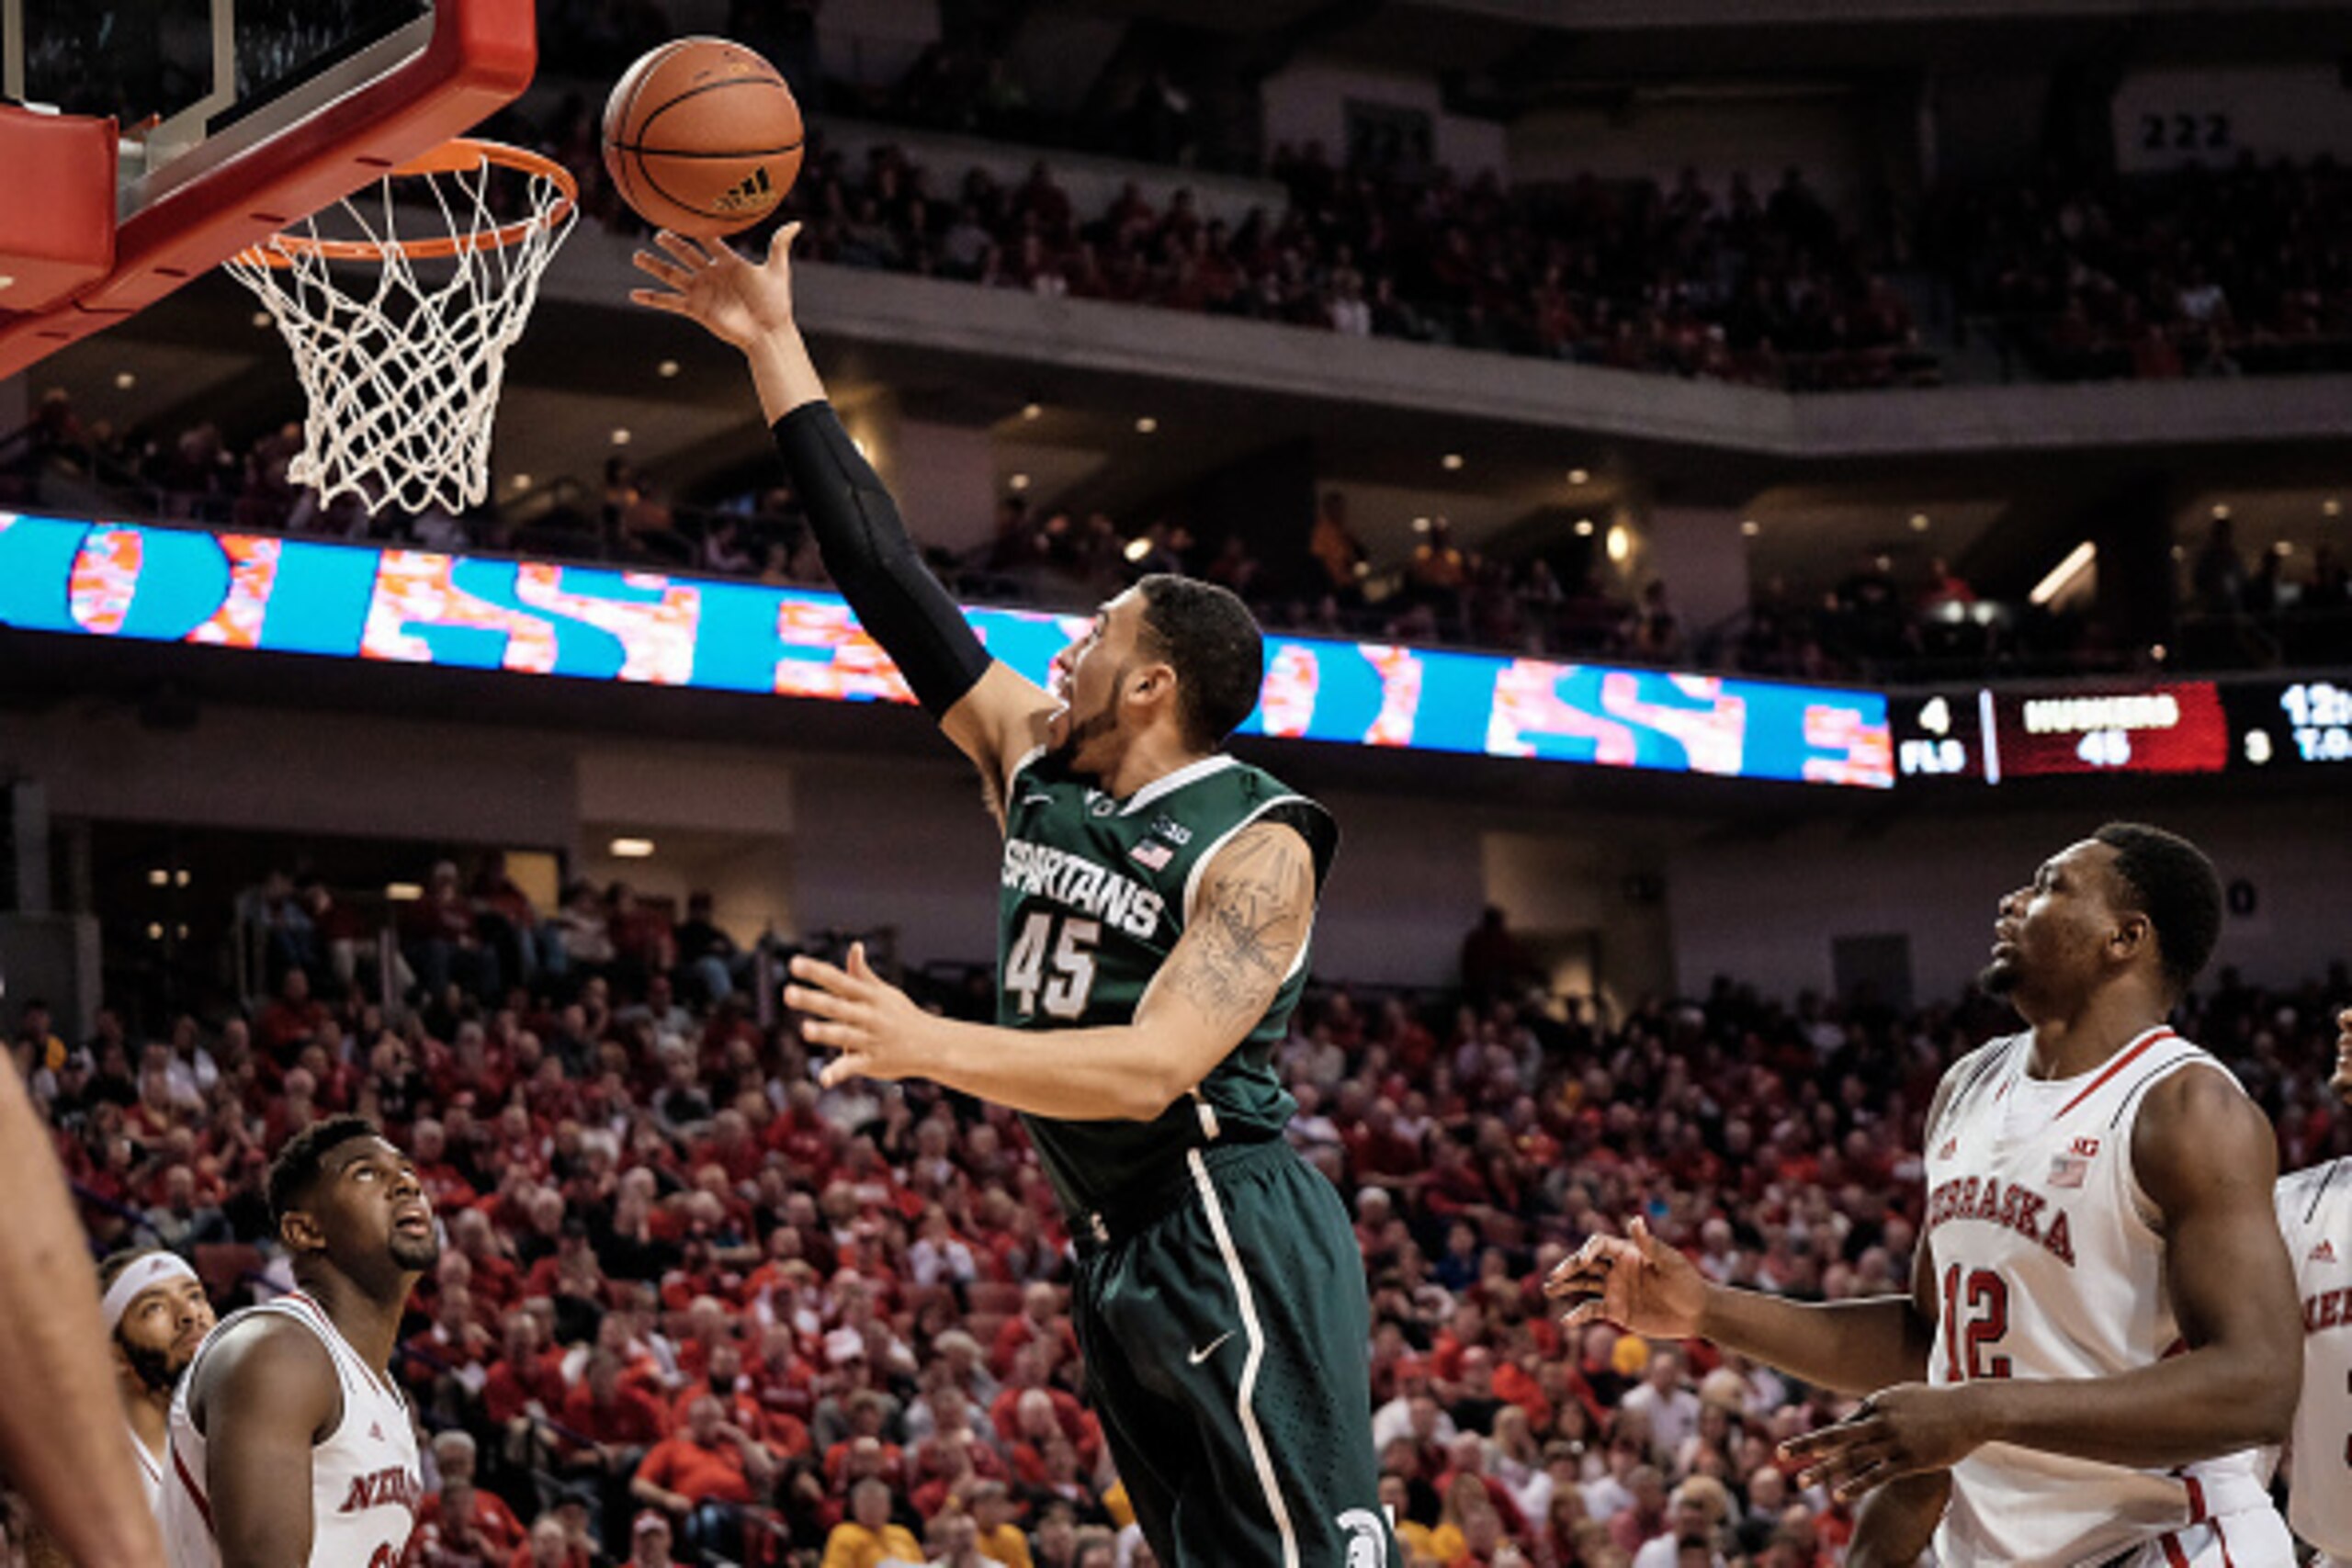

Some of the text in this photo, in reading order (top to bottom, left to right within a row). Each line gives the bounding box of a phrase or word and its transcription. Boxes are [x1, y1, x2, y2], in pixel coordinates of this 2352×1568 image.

[2141, 113, 2228, 149] 222
[1919, 697, 1950, 735] 4
[1001, 838, 1165, 938] SPARTANS
[1004, 913, 1101, 1020] 45
[1944, 1263, 2011, 1382] 12
